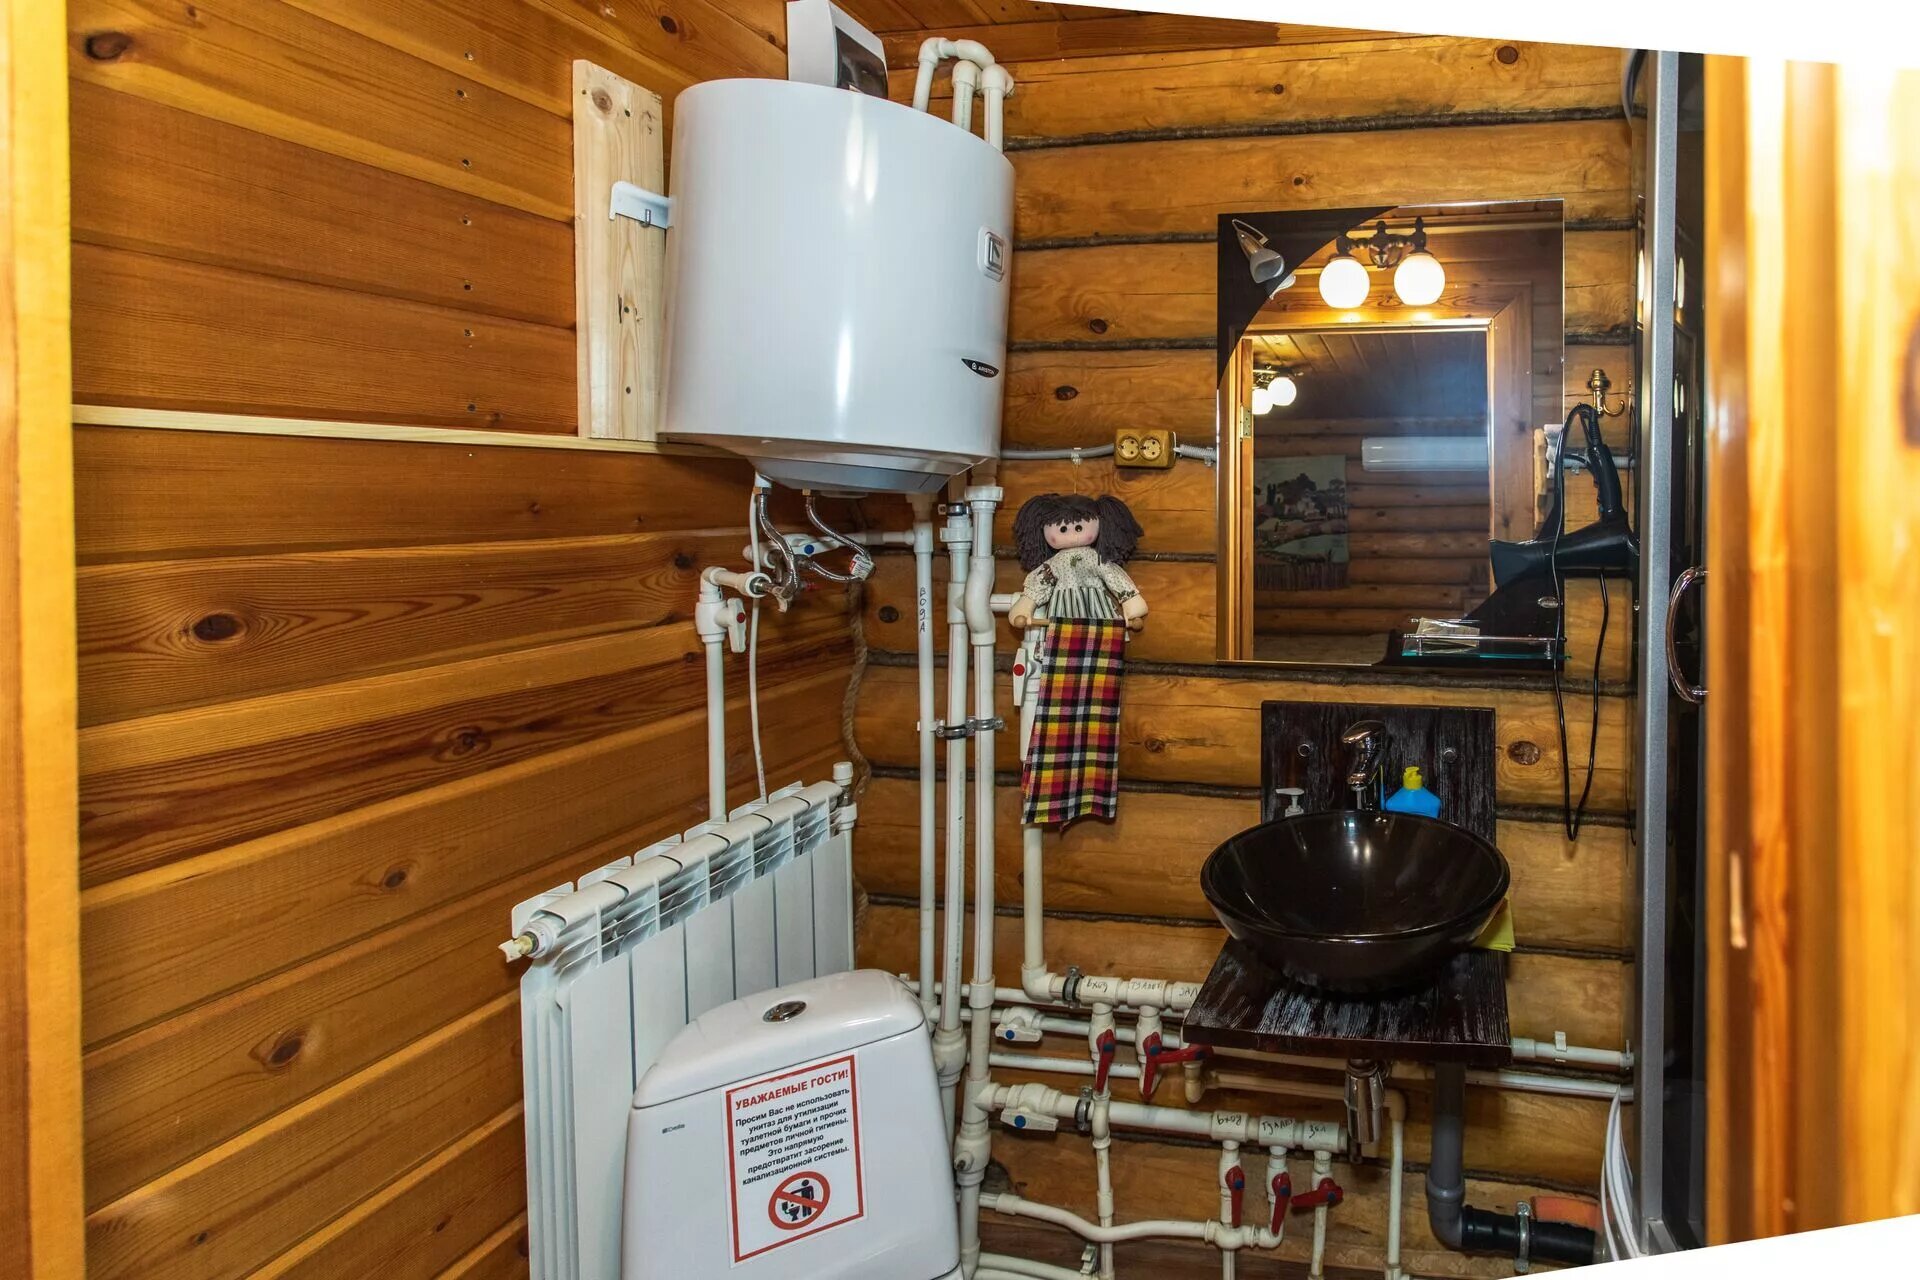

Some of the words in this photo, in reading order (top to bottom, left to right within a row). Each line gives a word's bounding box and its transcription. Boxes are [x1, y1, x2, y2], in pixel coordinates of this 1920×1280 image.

[735, 1081, 808, 1110] УВАЖАЕМЫЕ
[810, 1069, 849, 1088] ГОСТИ!
[735, 1112, 767, 1127] Просим
[768, 1108, 784, 1117] Вас
[785, 1104, 795, 1112] не
[796, 1088, 850, 1108] использовать
[740, 1128, 782, 1146] туалетной
[783, 1118, 812, 1133] бумаги
[819, 1108, 847, 1121] прочих
[740, 1138, 784, 1156] предметов
[785, 1127, 814, 1142] личной
[815, 1117, 849, 1132] гигиены.
[748, 1121, 776, 1135] унитаз
[777, 1114, 793, 1125] для
[794, 1100, 839, 1120] утилизации
[747, 1151, 803, 1174] предотвратит
[804, 1137, 844, 1155] засорение
[767, 1147, 783, 1157] Это
[784, 1134, 825, 1152] напрямую
[742, 1157, 813, 1185] канализационной
[813, 1146, 850, 1162] системы.
